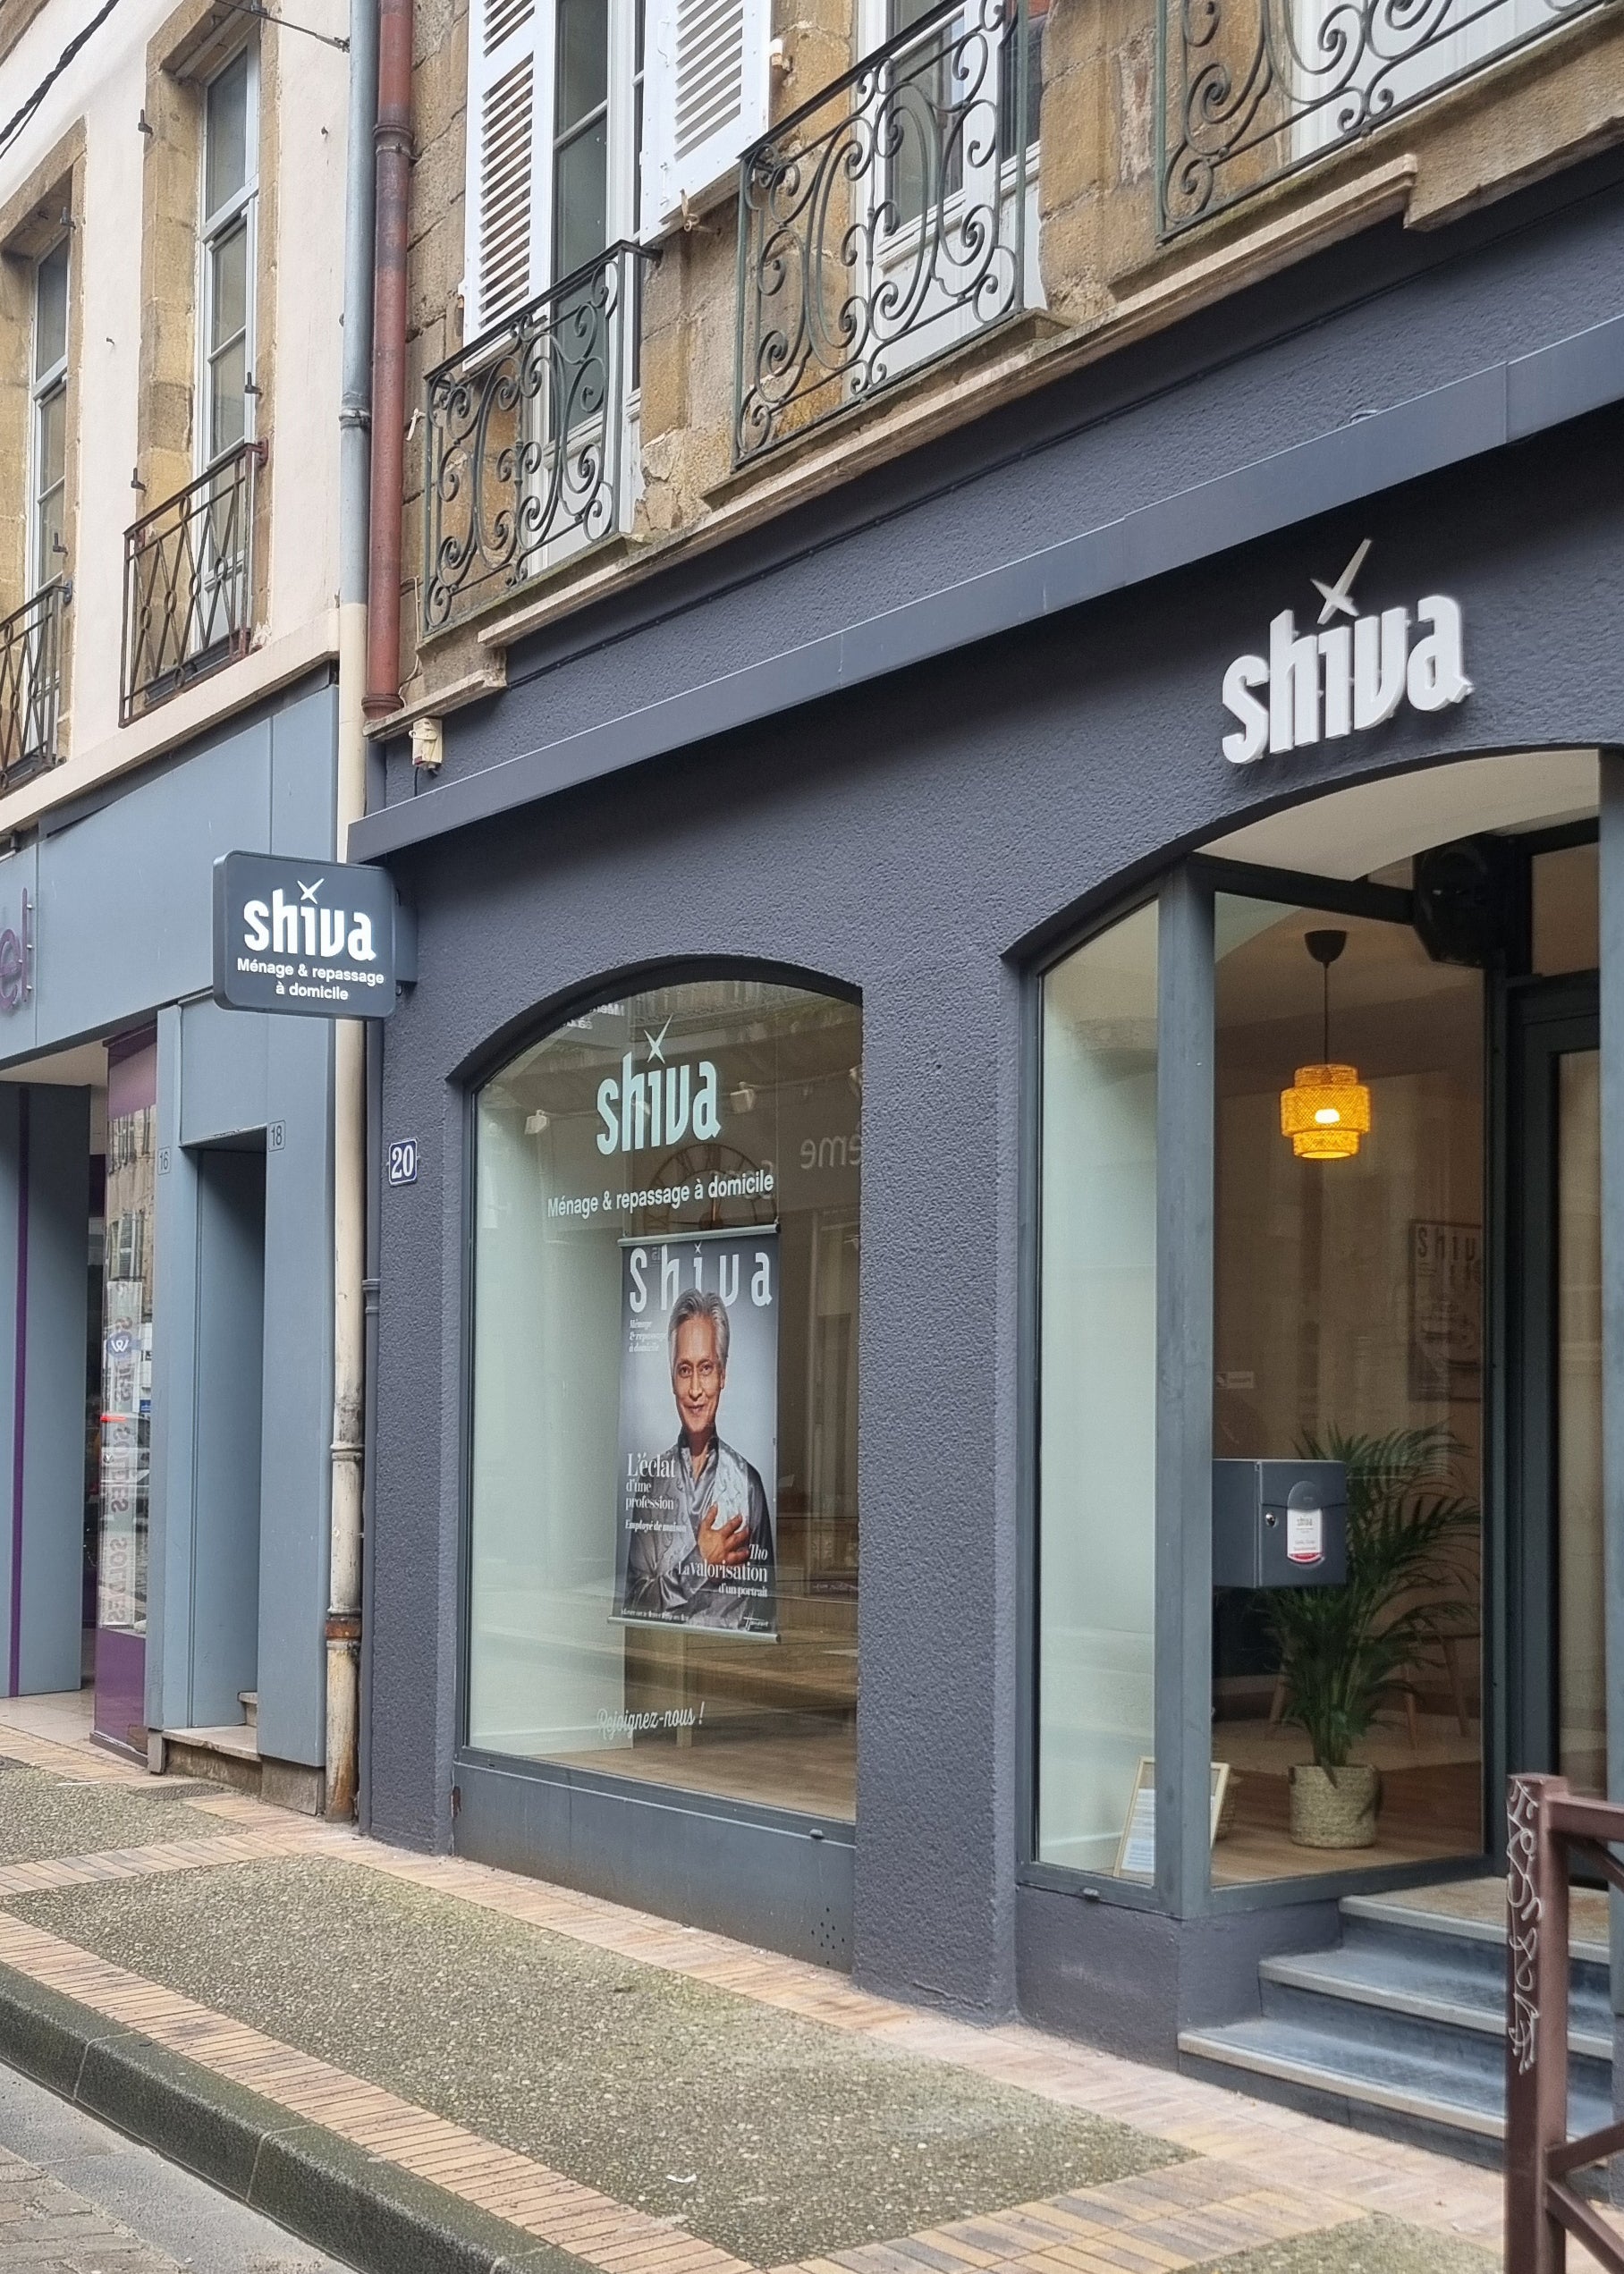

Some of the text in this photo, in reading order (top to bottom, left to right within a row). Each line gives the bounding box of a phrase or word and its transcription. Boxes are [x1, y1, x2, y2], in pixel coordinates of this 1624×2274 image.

[1222, 538, 1475, 765] shiva
[243, 878, 376, 961] shiva
[237, 957, 385, 986] Ménage & repassage
[275, 981, 349, 1001] à domicile
[596, 1014, 721, 1155] shiva
[271, 1125, 283, 1146] 18
[159, 1151, 169, 1171] 16
[391, 1145, 414, 1179] 20
[547, 1196, 598, 1220] Ménage
[603, 1190, 613, 1212] &
[616, 1184, 689, 1213] repassage
[694, 1178, 704, 1200] à
[708, 1170, 774, 1198] domicile
[627, 1452, 676, 1478] L'éclat
[626, 1478, 651, 1492] d'une
[626, 1495, 674, 1510] profession
[690, 1559, 767, 1582] valorisation
[718, 1583, 767, 1598] d'un portrait
[597, 1701, 705, 1740] Rejoignez-nous !
